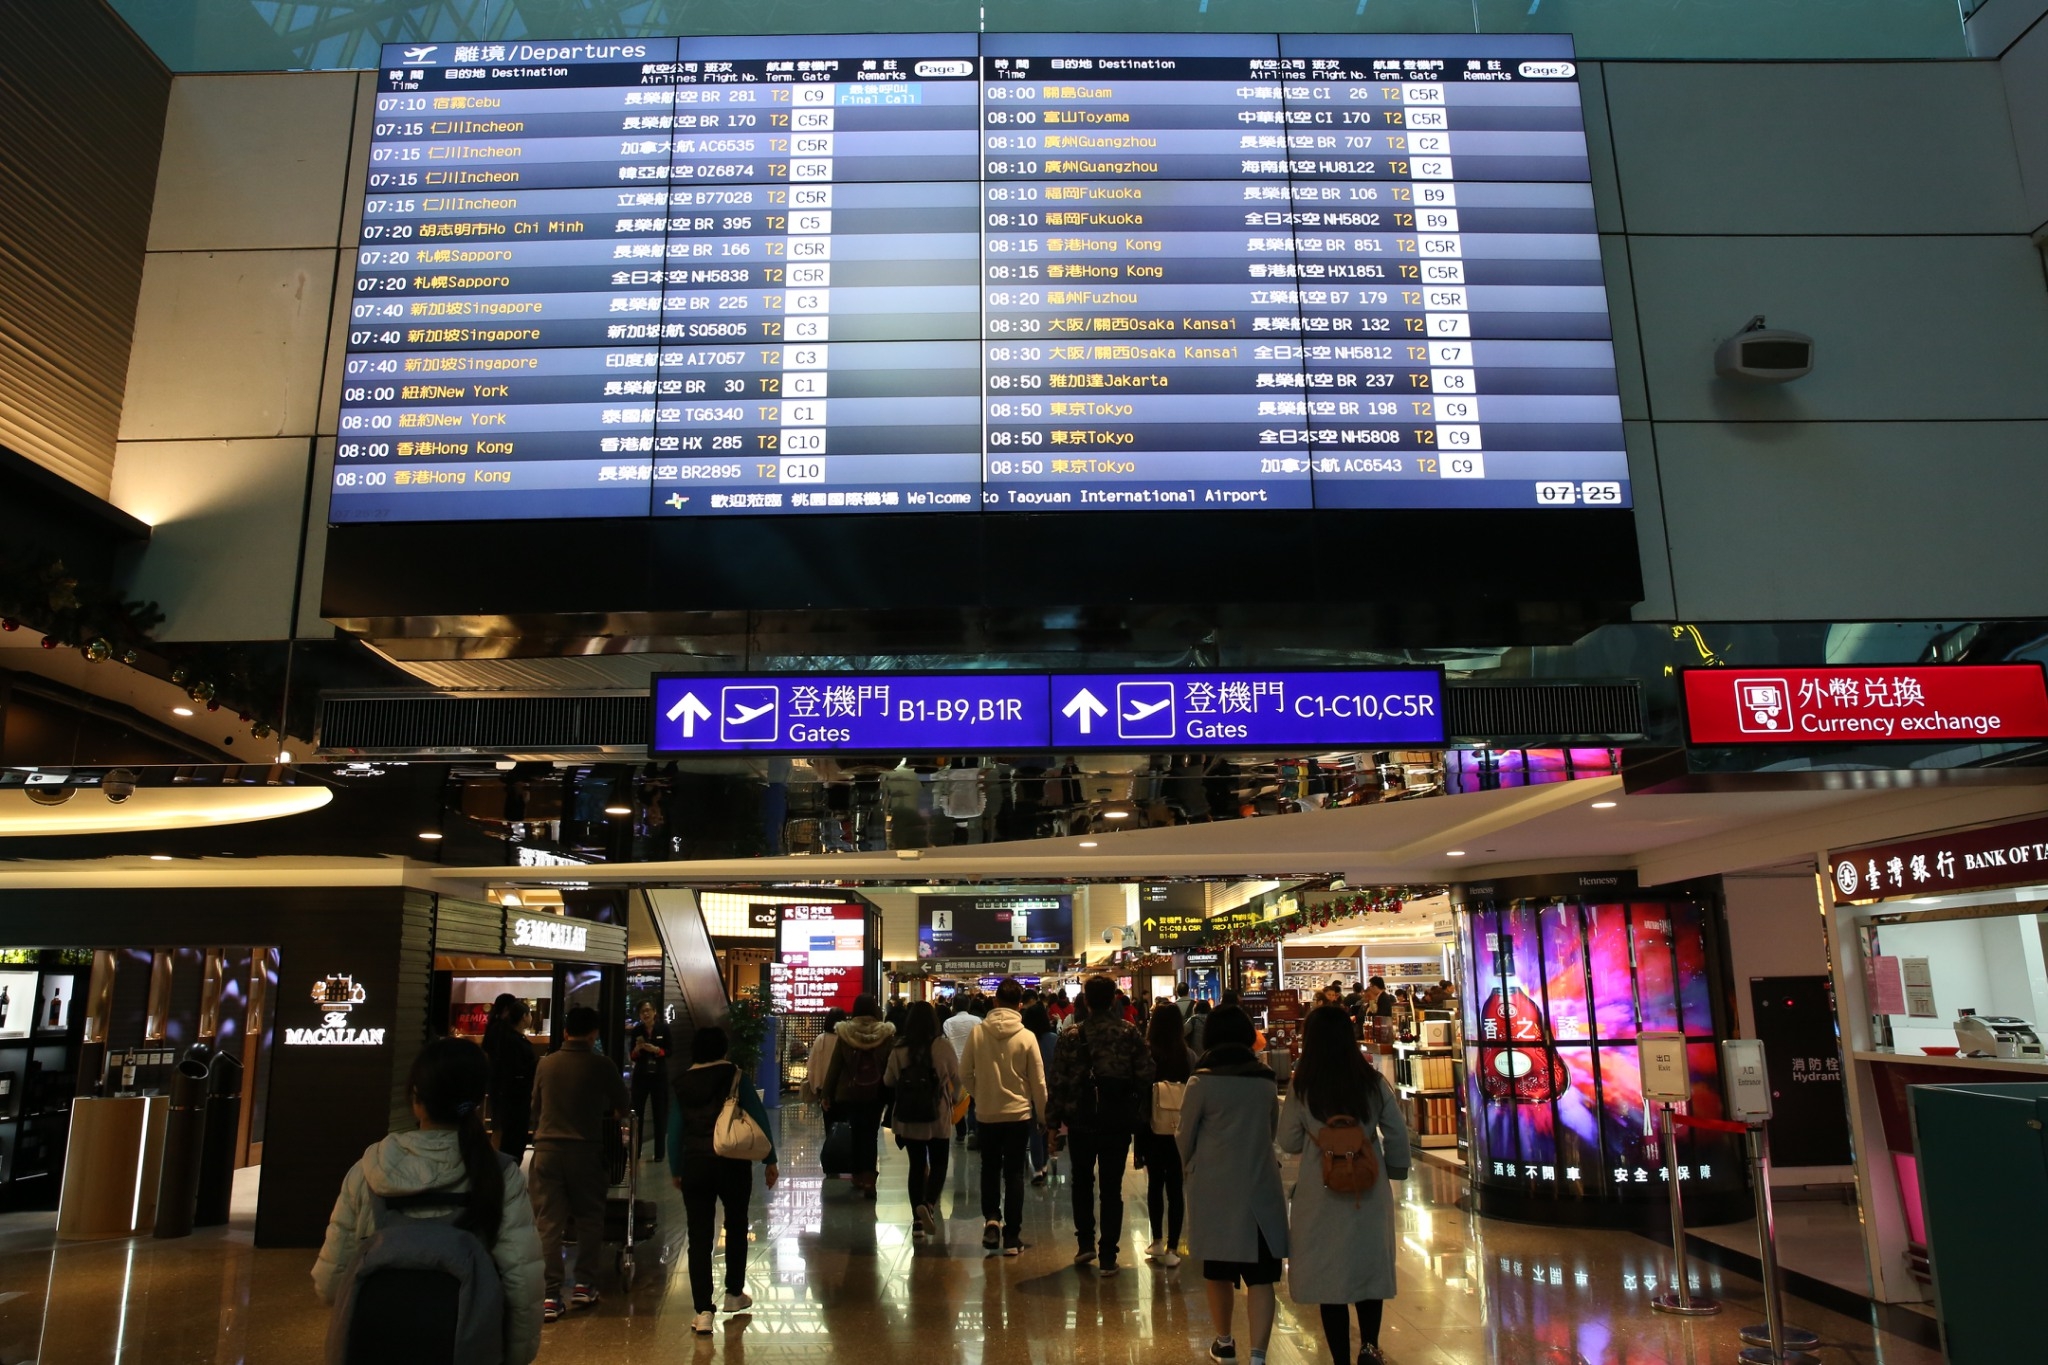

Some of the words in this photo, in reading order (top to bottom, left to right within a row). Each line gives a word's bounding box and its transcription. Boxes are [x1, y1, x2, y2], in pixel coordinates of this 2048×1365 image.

[455, 44, 645, 62] 離境/Departures
[959, 64, 968, 74] 1
[1099, 60, 1175, 68] Destination
[1524, 67, 1557, 75] Page
[445, 68, 485, 79] 目的地
[492, 67, 567, 77] Destination
[641, 75, 696, 83] Airlines
[704, 73, 738, 82] Flight
[742, 73, 758, 81] No.
[766, 73, 795, 81] Term.
[802, 73, 830, 81] Gate
[858, 71, 906, 80] Remarks
[392, 81, 418, 89] Time
[379, 98, 426, 110] 07:10
[805, 90, 823, 101] C9
[842, 95, 877, 104] Final
[886, 95, 914, 104] Call
[988, 87, 1035, 99] 08:00
[1410, 89, 1438, 100] C5R
[376, 123, 423, 135] 07:15
[798, 115, 828, 126] C5R
[988, 112, 1036, 123] 08:00
[1412, 114, 1441, 124] C5R
[373, 148, 420, 160] 07:15
[798, 140, 827, 151] C5R
[988, 137, 1036, 148] 08:10
[1420, 138, 1438, 149] C2
[371, 173, 417, 186] 07:15
[797, 165, 826, 176] C5R
[989, 162, 1037, 173] 08:10
[1422, 163, 1441, 174] C2
[368, 200, 414, 212] 07:15
[796, 191, 826, 203] C5R
[989, 188, 1037, 200] 08:10
[1425, 189, 1444, 201] B9
[364, 226, 412, 238] 07:20
[514, 222, 539, 234] Chi
[548, 222, 584, 232] Minh
[800, 217, 820, 229] C5
[989, 214, 1037, 226] 08:10
[1427, 215, 1447, 226] B9
[361, 251, 409, 264] 07:20
[794, 243, 824, 255] C5R
[989, 240, 1038, 252] 08:15
[1426, 241, 1454, 252] C5R
[989, 266, 1038, 278] 08:15
[1428, 267, 1457, 278] C5R
[358, 278, 406, 291] 07:20
[793, 269, 823, 281] C5R
[355, 304, 403, 317] 07:40
[798, 296, 817, 308] C3
[990, 293, 1039, 305] 08:20
[1431, 293, 1460, 305] C5R
[990, 319, 1040, 332] 08:30
[1439, 320, 1458, 332] C7
[352, 331, 400, 344] 07:40
[797, 323, 817, 335] C3
[990, 348, 1040, 360] 08:30
[1441, 348, 1460, 360] C7
[349, 360, 397, 373] 07:40
[796, 352, 816, 364] C3
[990, 375, 1041, 388] 08:50
[1444, 376, 1464, 388] C8
[345, 387, 394, 401] 08:00
[795, 379, 814, 392] C1
[991, 403, 1041, 416] 08:50
[1447, 404, 1467, 416] C9
[342, 415, 391, 429] 08:00
[794, 407, 813, 420] C1
[991, 432, 1042, 445] 08:50
[1450, 432, 1469, 444] C9
[339, 443, 389, 457] 08:00
[788, 436, 819, 449] C10
[991, 460, 1043, 474] 08:50
[1452, 460, 1472, 472] C9
[336, 472, 386, 486] 08:00
[787, 465, 818, 477] C10
[907, 492, 971, 504] Welcome
[983, 491, 999, 503] to
[1008, 491, 1071, 504] Taoyuan
[1081, 490, 1195, 502] International
[1205, 489, 1267, 502] Airport
[1543, 486, 1615, 501] 07:25
[1184, 681, 1284, 714] 登機門
[1797, 676, 1925, 709] 外幣兌換
[789, 685, 889, 717] 登機門
[1295, 695, 1434, 720] C1-C10,C5R
[900, 699, 1022, 724] B1-B9,B1R
[1187, 720, 1247, 738] Gates
[1801, 713, 1894, 735] Currency
[1901, 711, 2001, 734] exchange
[790, 724, 850, 742] Gates
[1965, 849, 2007, 870] BANK
[2009, 847, 2030, 864] OF
[1579, 877, 1617, 885] Hennessy
[284, 1028, 385, 1045] MACALLAN
[1792, 1058, 1839, 1071] 消防栓
[1793, 1072, 1840, 1083] Hydrant
